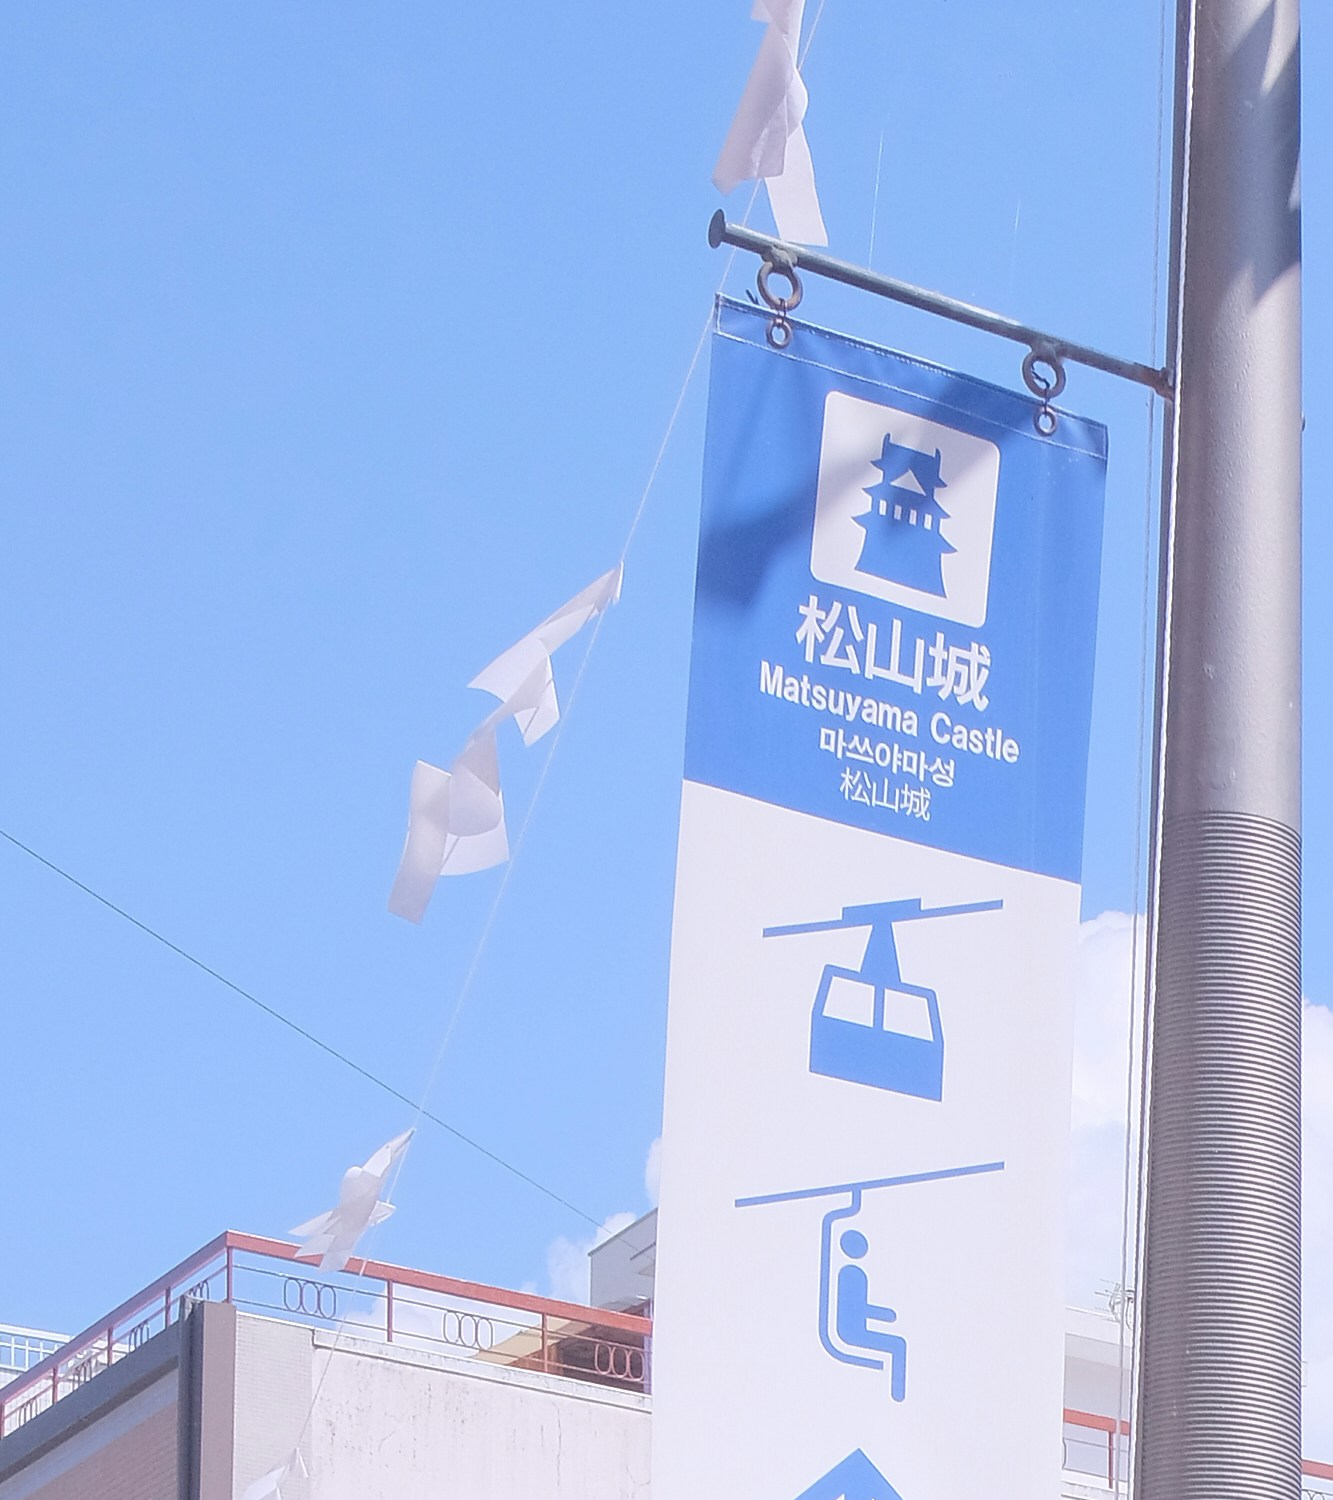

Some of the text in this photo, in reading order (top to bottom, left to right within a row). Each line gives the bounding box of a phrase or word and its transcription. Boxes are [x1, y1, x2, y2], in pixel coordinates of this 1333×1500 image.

[795, 595, 991, 712] 松山城
[759, 660, 1020, 764] Matsuyama Castle
[818, 726, 956, 788] 마쓰야마성
[839, 768, 931, 822] 松山城
